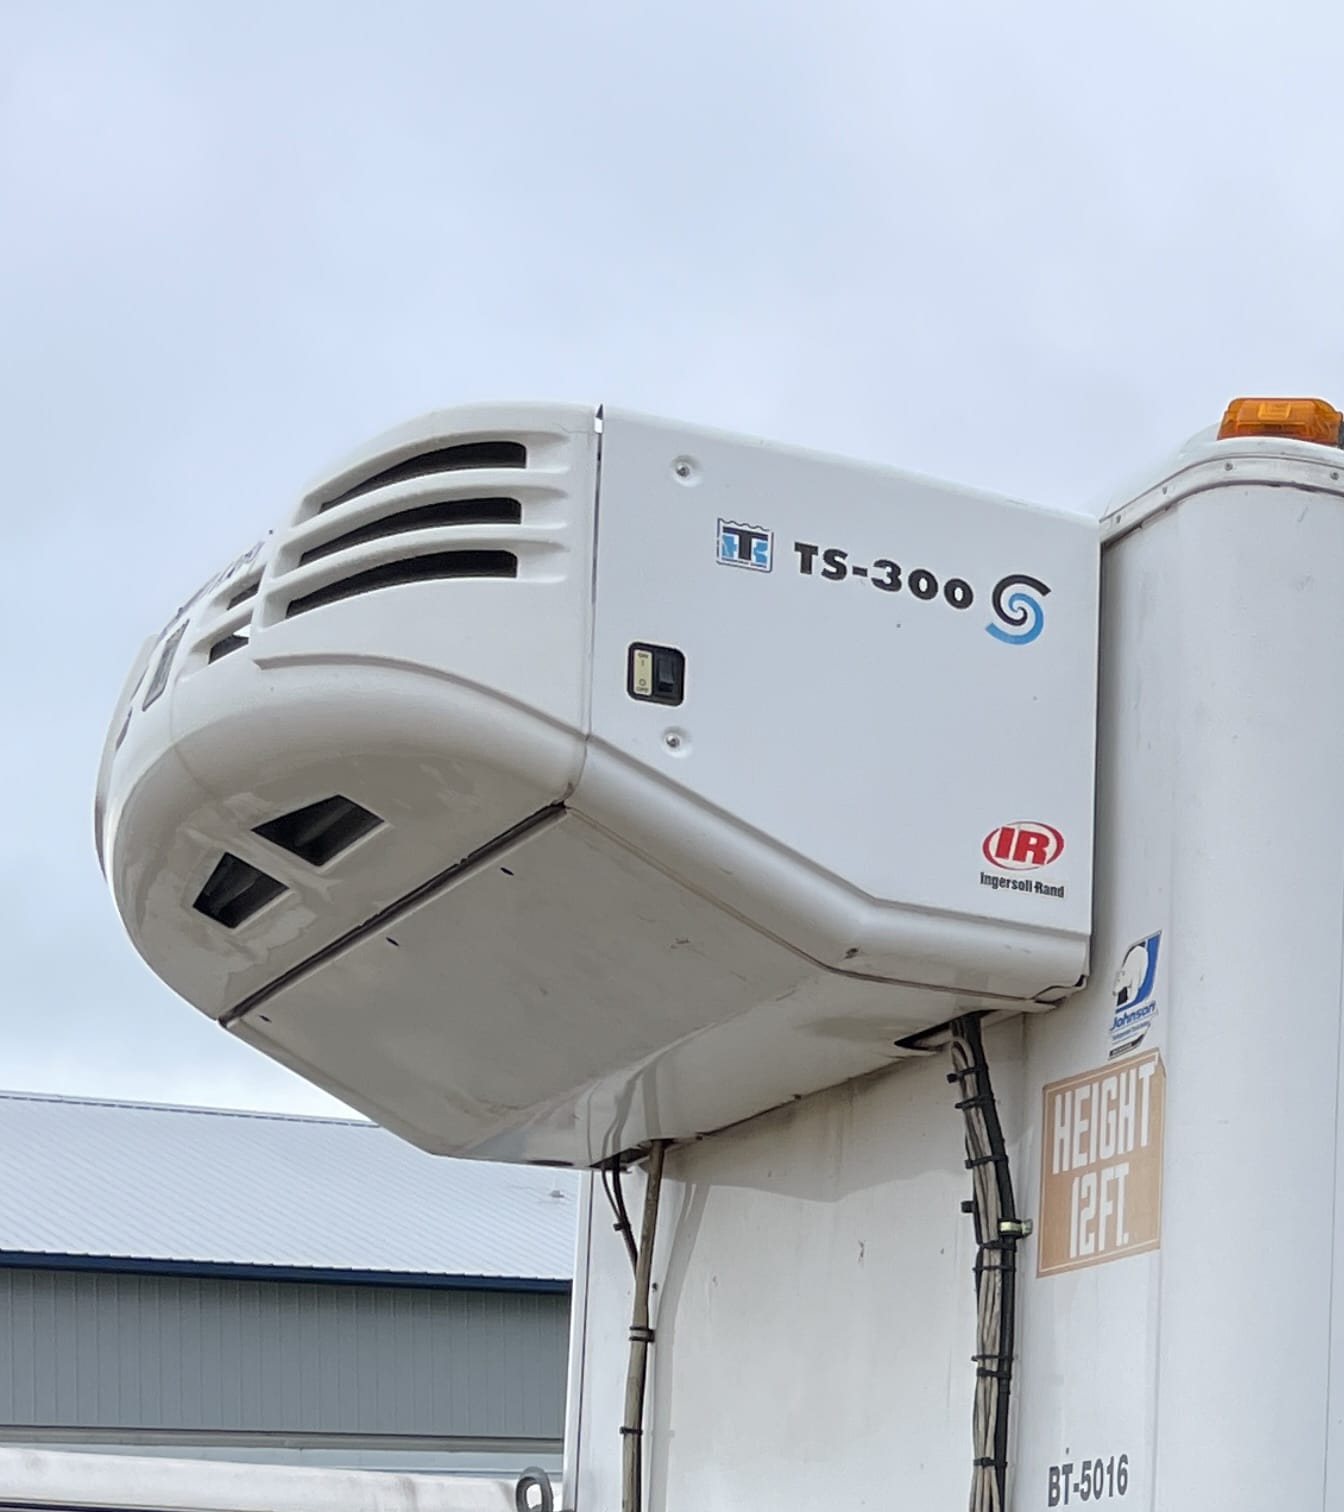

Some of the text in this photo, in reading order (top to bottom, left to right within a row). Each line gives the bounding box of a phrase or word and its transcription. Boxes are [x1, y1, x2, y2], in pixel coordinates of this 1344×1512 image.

[794, 541, 974, 609] TS-300
[995, 826, 1050, 866] IR
[1109, 1000, 1156, 1032] Johnson
[1052, 1062, 1156, 1175] HEIGHT
[1048, 1454, 1129, 1507] BT-5016
